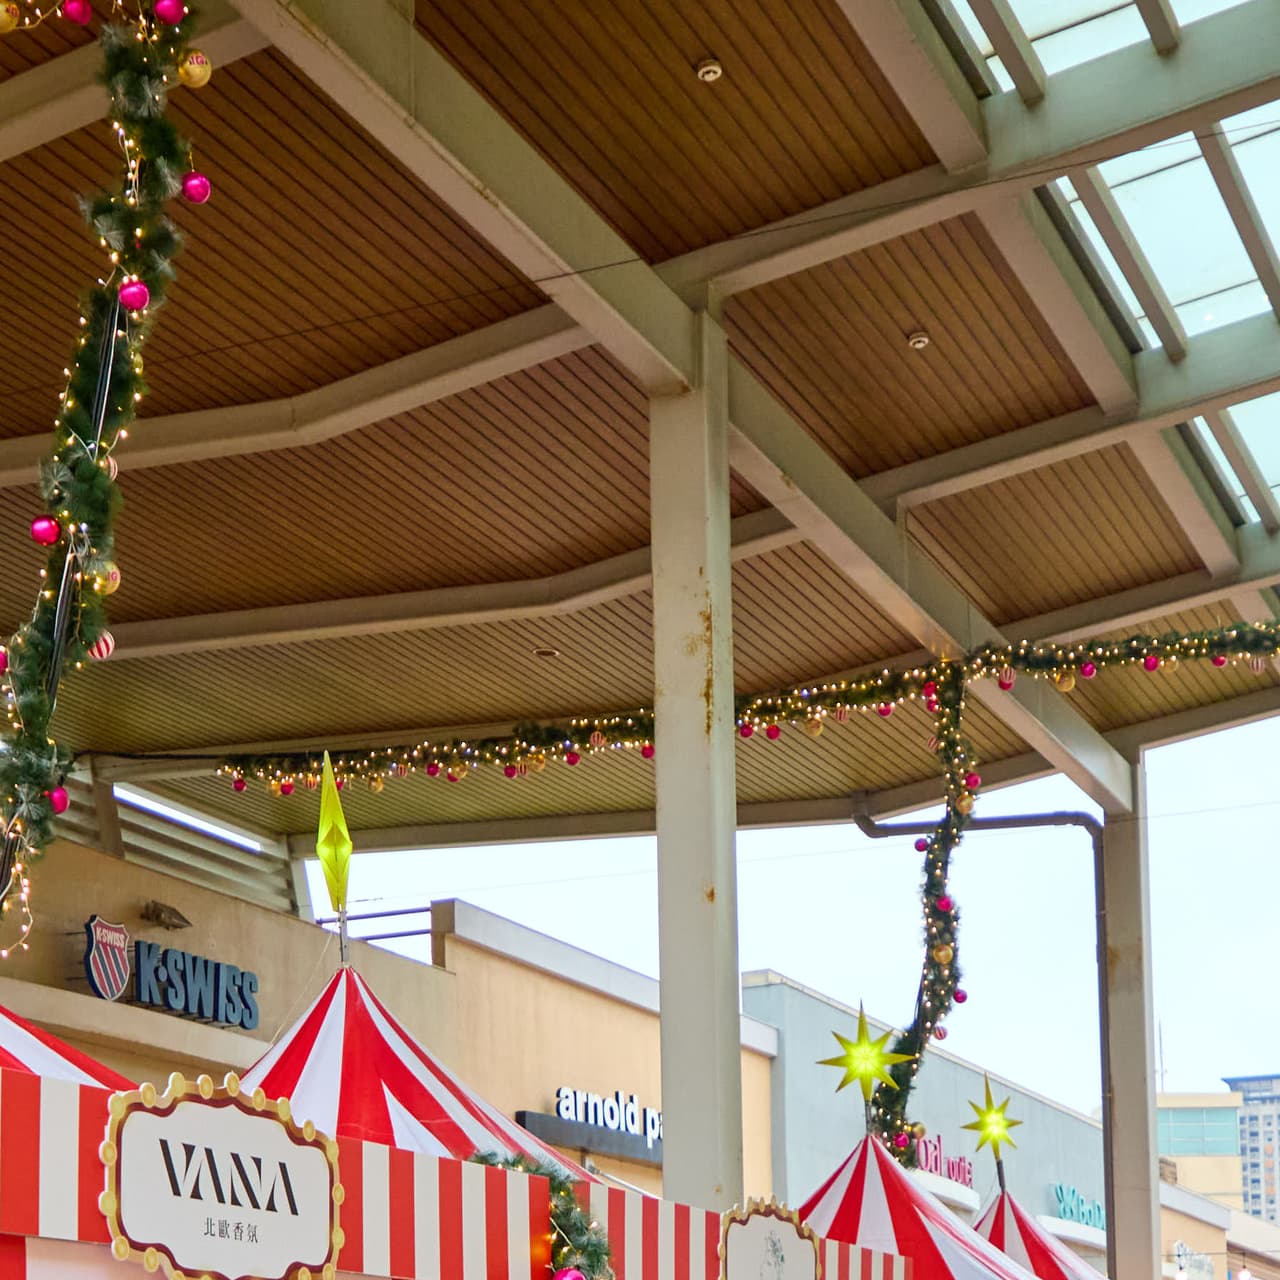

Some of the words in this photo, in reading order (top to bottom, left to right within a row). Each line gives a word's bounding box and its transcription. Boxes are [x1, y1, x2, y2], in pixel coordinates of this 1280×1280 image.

[556, 1087, 641, 1135] arnold
[159, 1138, 299, 1216] VANA
[204, 1217, 259, 1243] 北歐香氛
